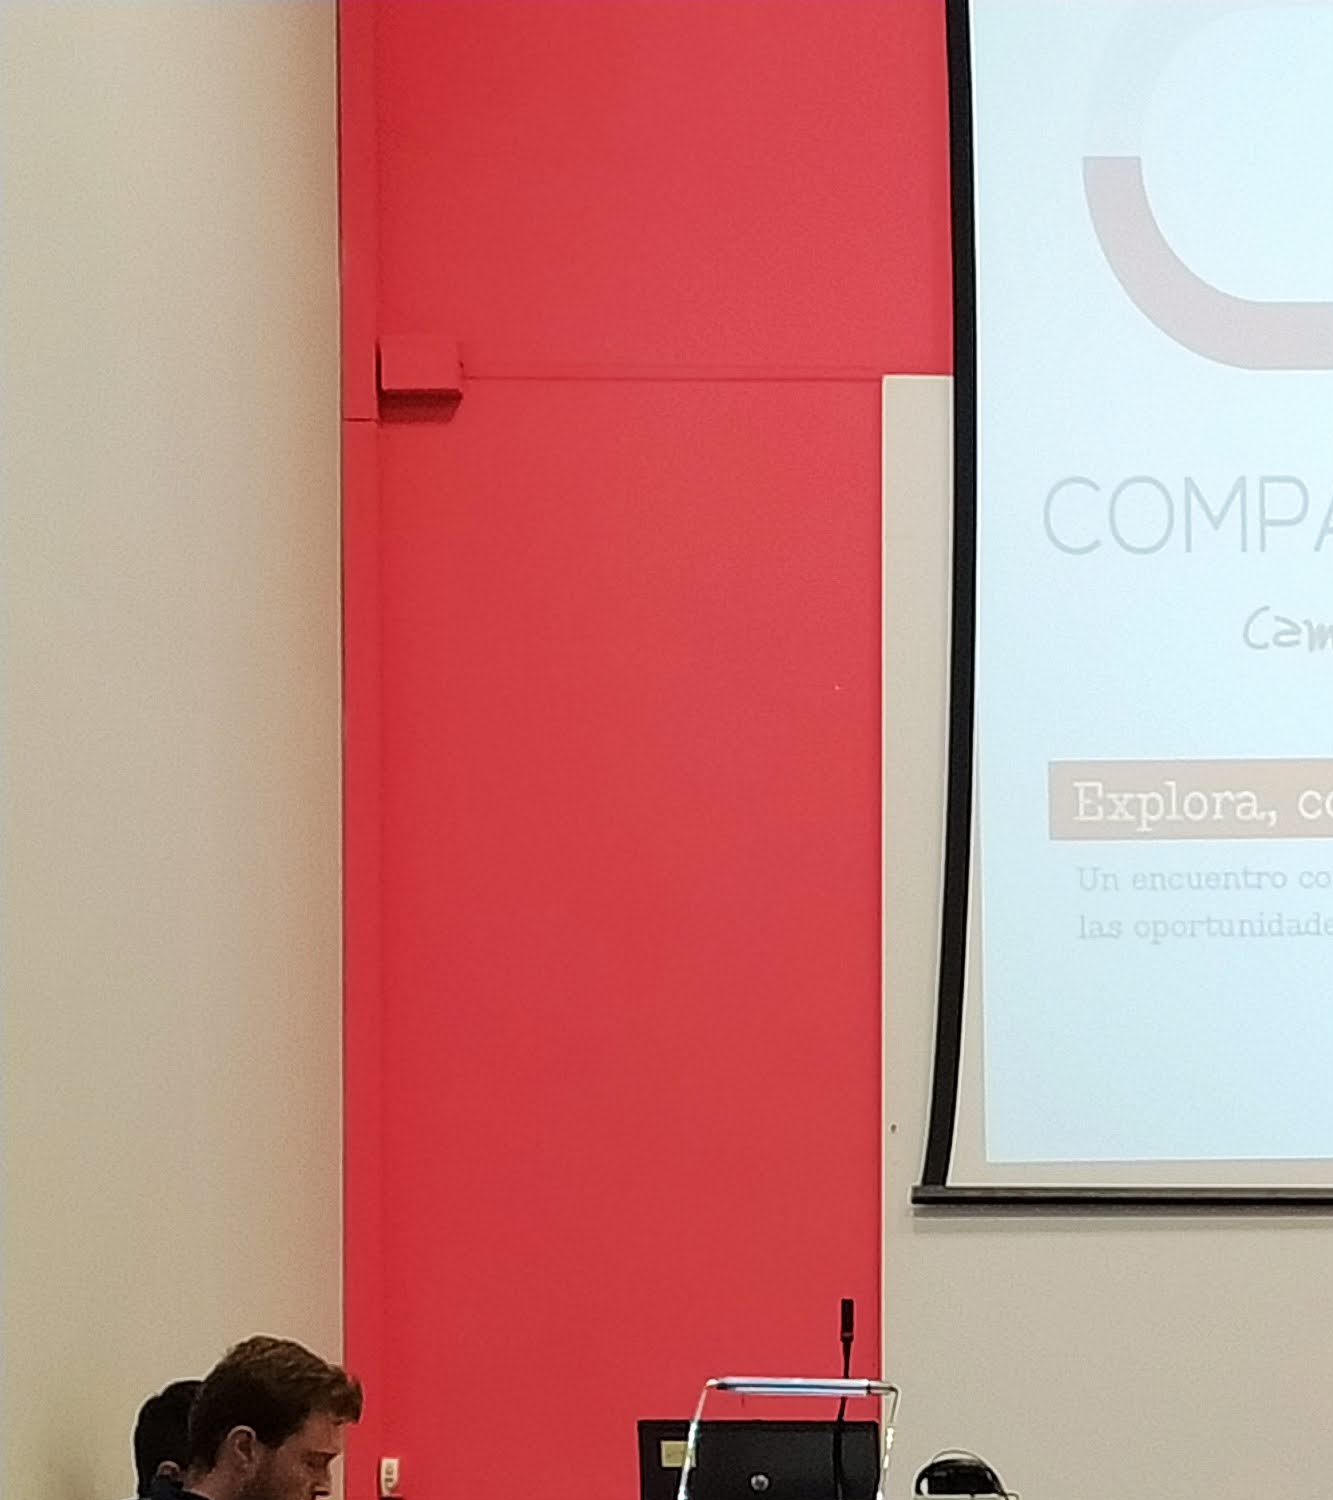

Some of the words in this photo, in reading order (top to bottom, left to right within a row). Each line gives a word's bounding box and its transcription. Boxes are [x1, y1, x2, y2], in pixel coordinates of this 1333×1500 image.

[1073, 781, 1277, 832] Explora,
[1076, 867, 1119, 892] Un
[1132, 867, 1287, 891] encuentro
[1078, 914, 1123, 940] las
